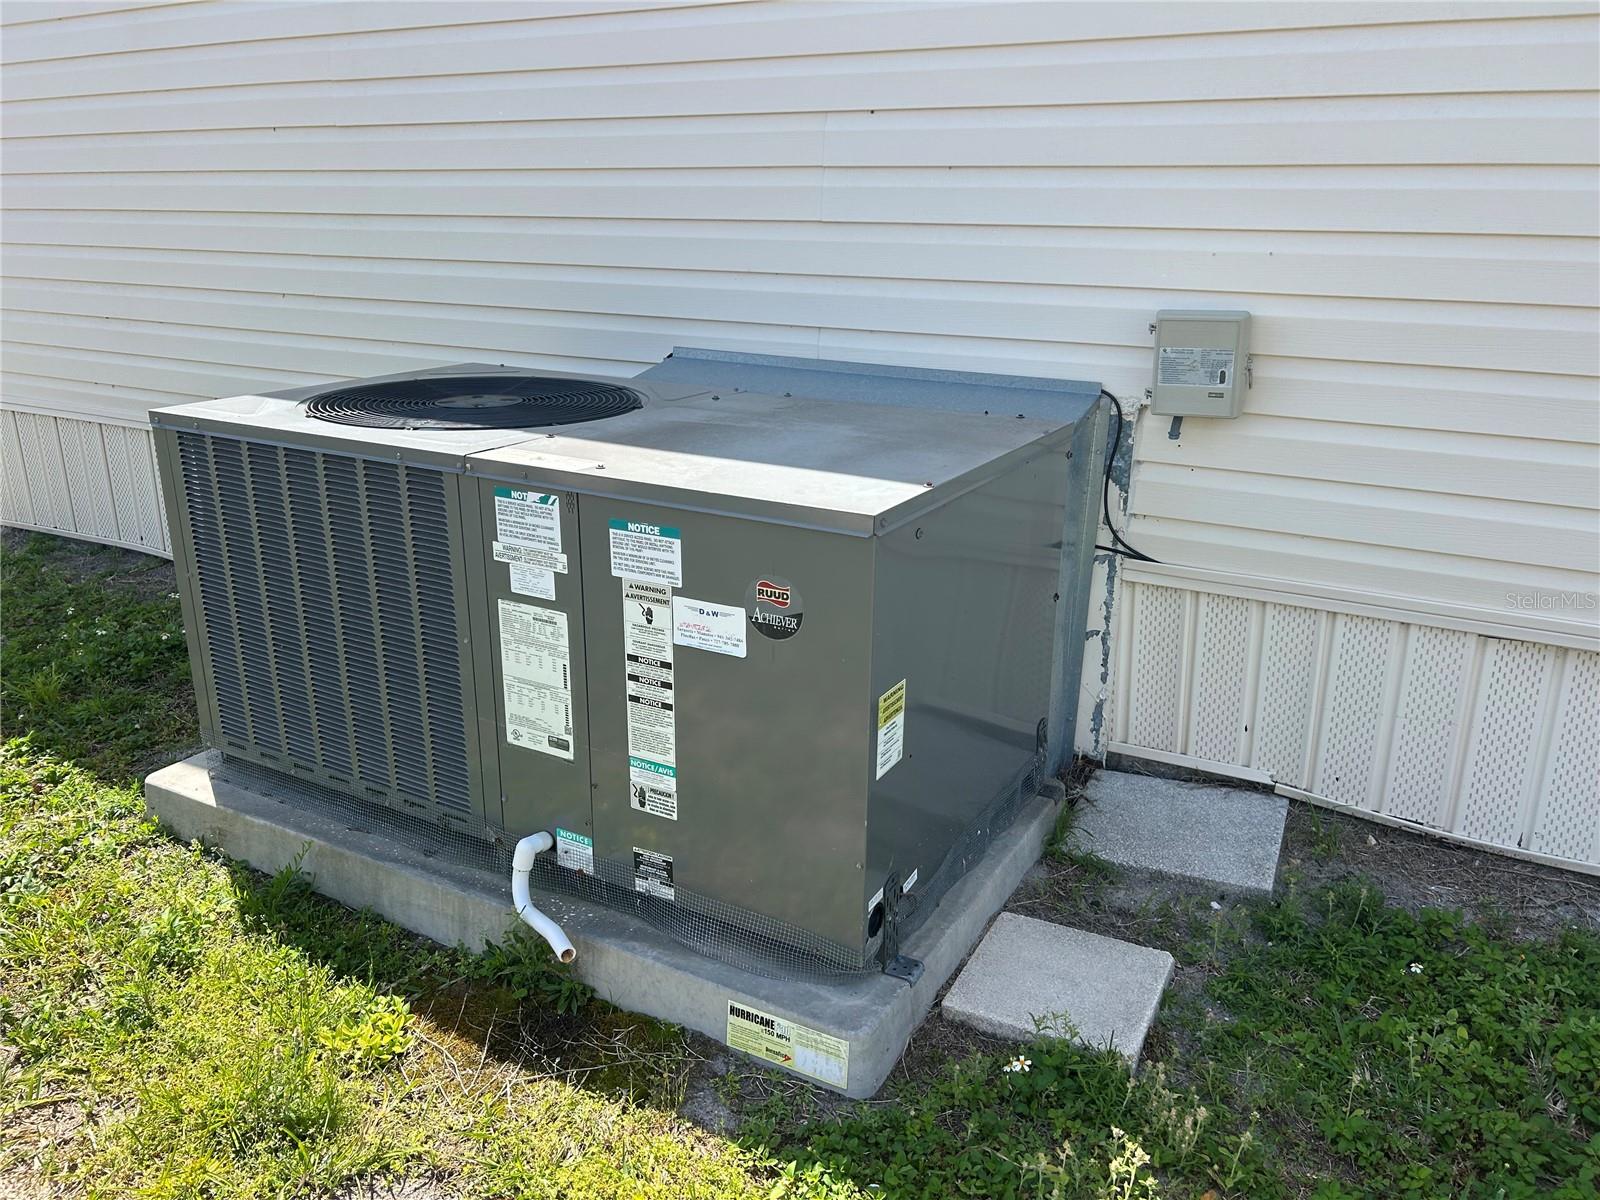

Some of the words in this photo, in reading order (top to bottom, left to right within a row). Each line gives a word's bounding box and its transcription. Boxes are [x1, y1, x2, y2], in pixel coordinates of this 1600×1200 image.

[627, 522, 660, 535] NOTICE
[634, 583, 667, 595] WARNING
[757, 588, 790, 601] RUUD
[629, 593, 670, 606] AVERTISSEMENT
[711, 610, 719, 618] W
[752, 606, 798, 629] ACHIEVER
[638, 656, 660, 667] NOTICE
[638, 676, 661, 687] NOTICE
[639, 697, 662, 708] NOTICE
[560, 829, 589, 845] NOTICE
[729, 1004, 775, 1030] HURRICANE
[764, 1028, 775, 1037] 150
[776, 1032, 791, 1043] MPH
